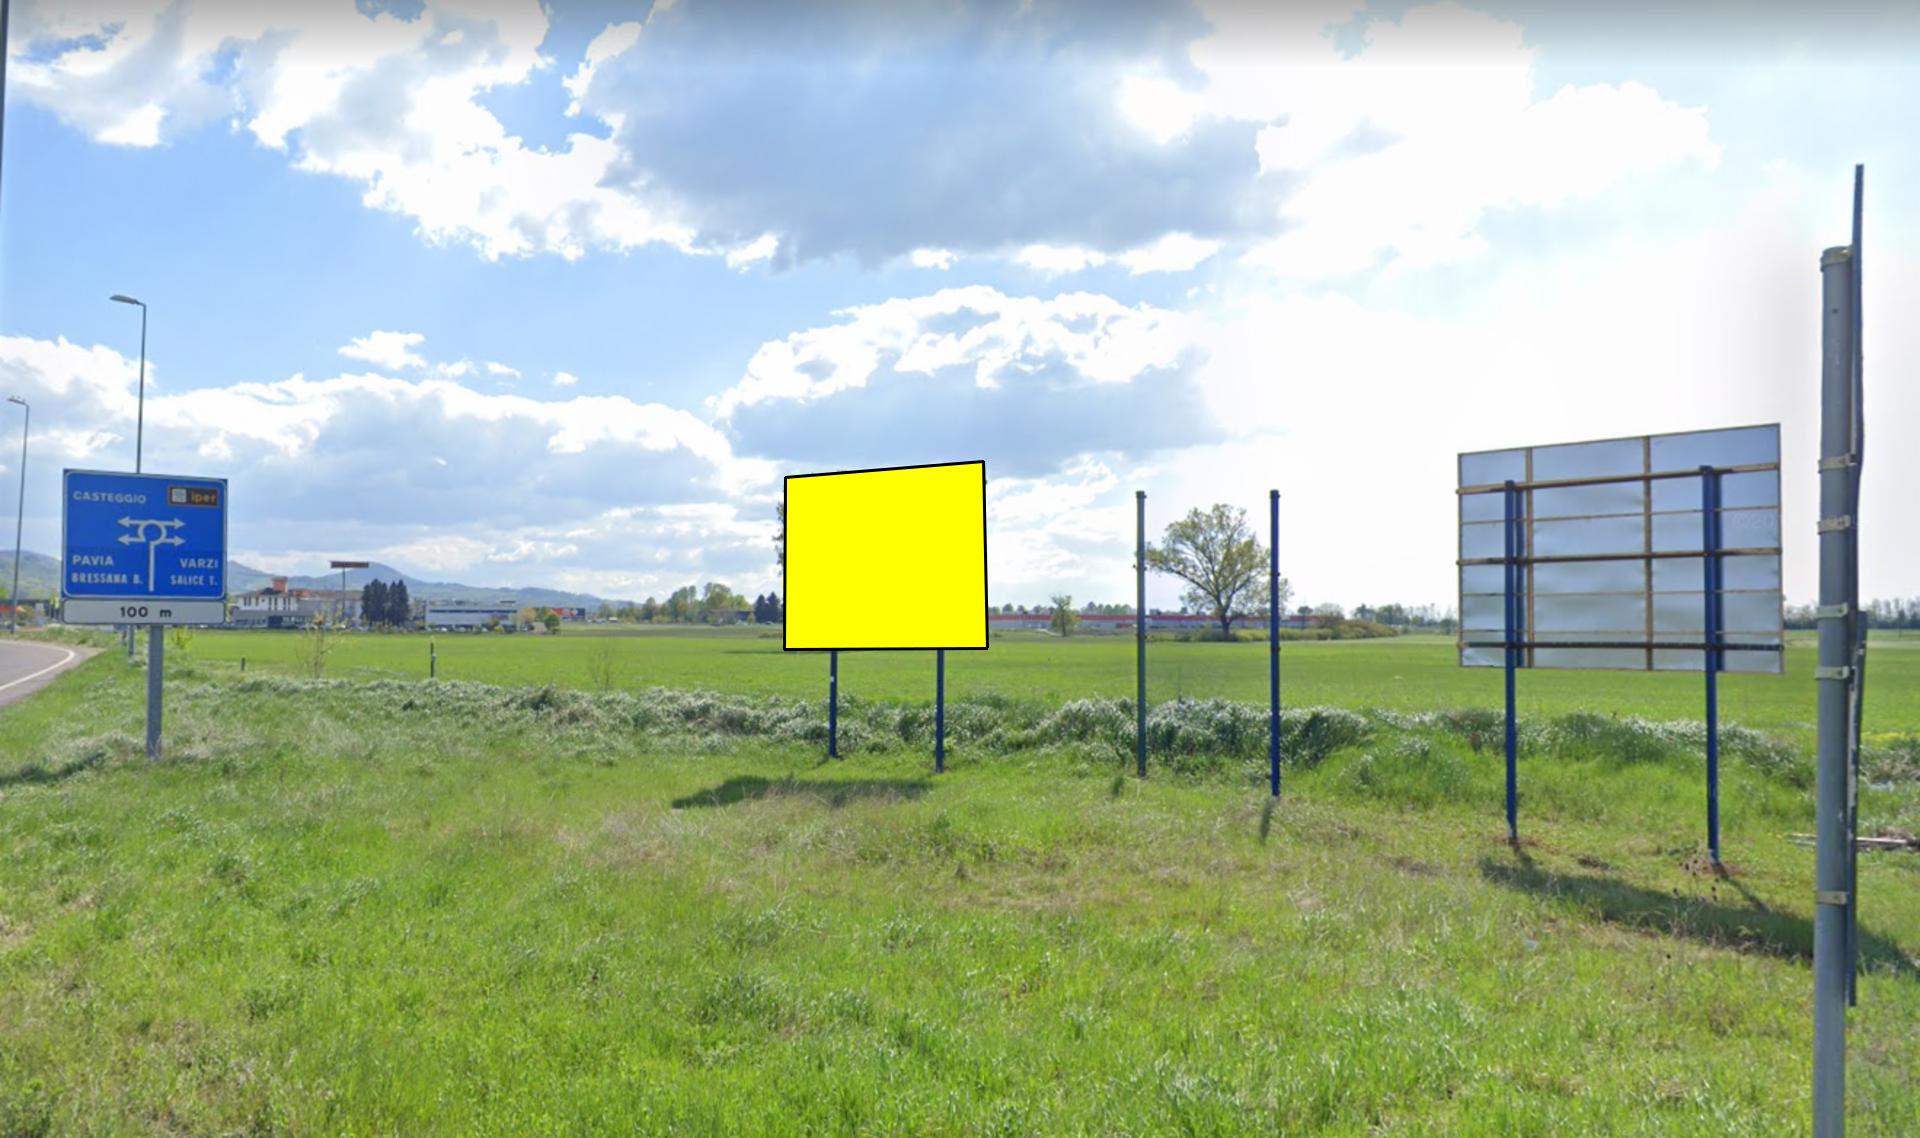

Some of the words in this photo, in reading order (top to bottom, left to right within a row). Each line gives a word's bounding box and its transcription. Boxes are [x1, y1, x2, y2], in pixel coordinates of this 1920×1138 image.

[73, 491, 147, 504] CASTEGGIO
[72, 555, 114, 566] PAVIA
[179, 558, 218, 568] VARZI
[71, 573, 127, 584] BRESSANA
[170, 575, 204, 585] SALICE
[120, 607, 148, 618] 100
[160, 608, 172, 617] m
